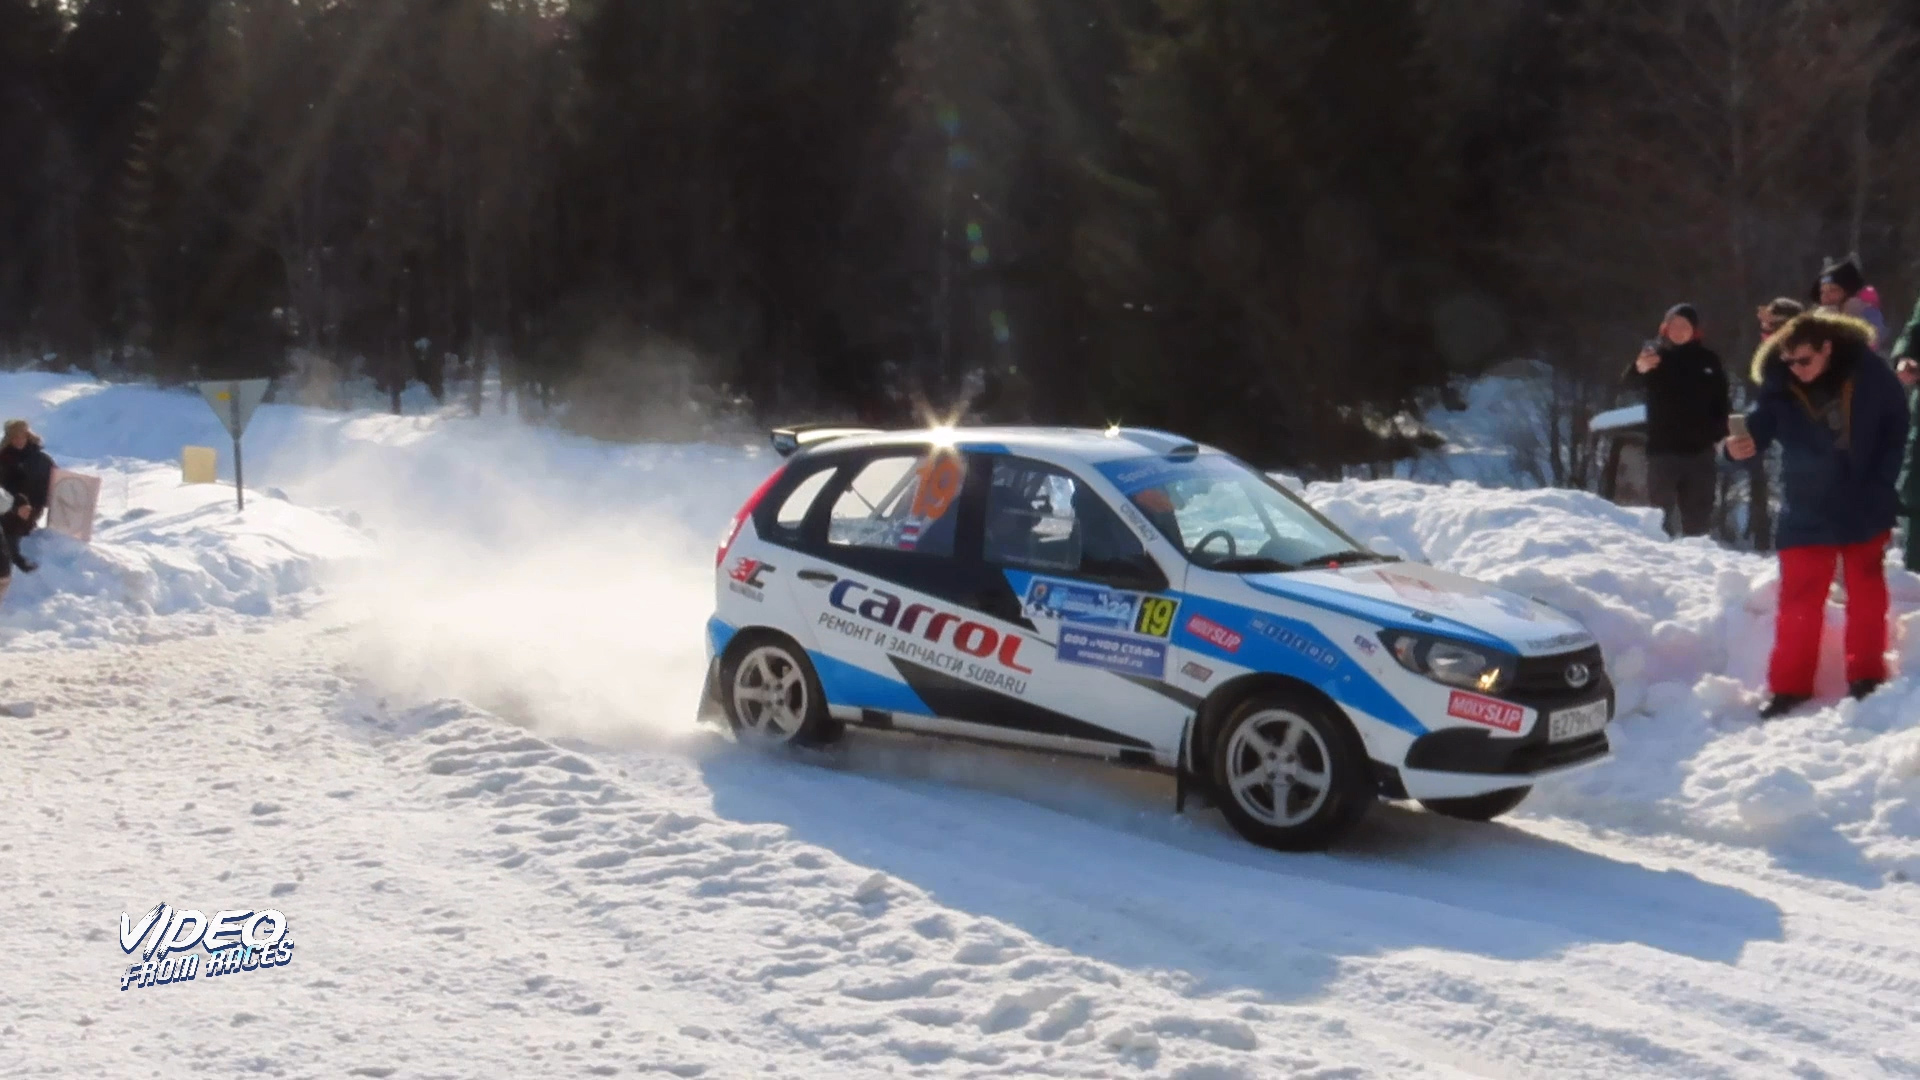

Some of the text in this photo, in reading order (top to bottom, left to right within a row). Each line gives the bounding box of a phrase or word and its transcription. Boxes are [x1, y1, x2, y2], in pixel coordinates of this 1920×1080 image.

[911, 452, 962, 520] 19
[1140, 599, 1173, 636] 19
[818, 612, 1027, 695] РЕМОНТ И ЗАПЧАСТИ SUBARU
[1451, 696, 1523, 728] MOLYSLIP
